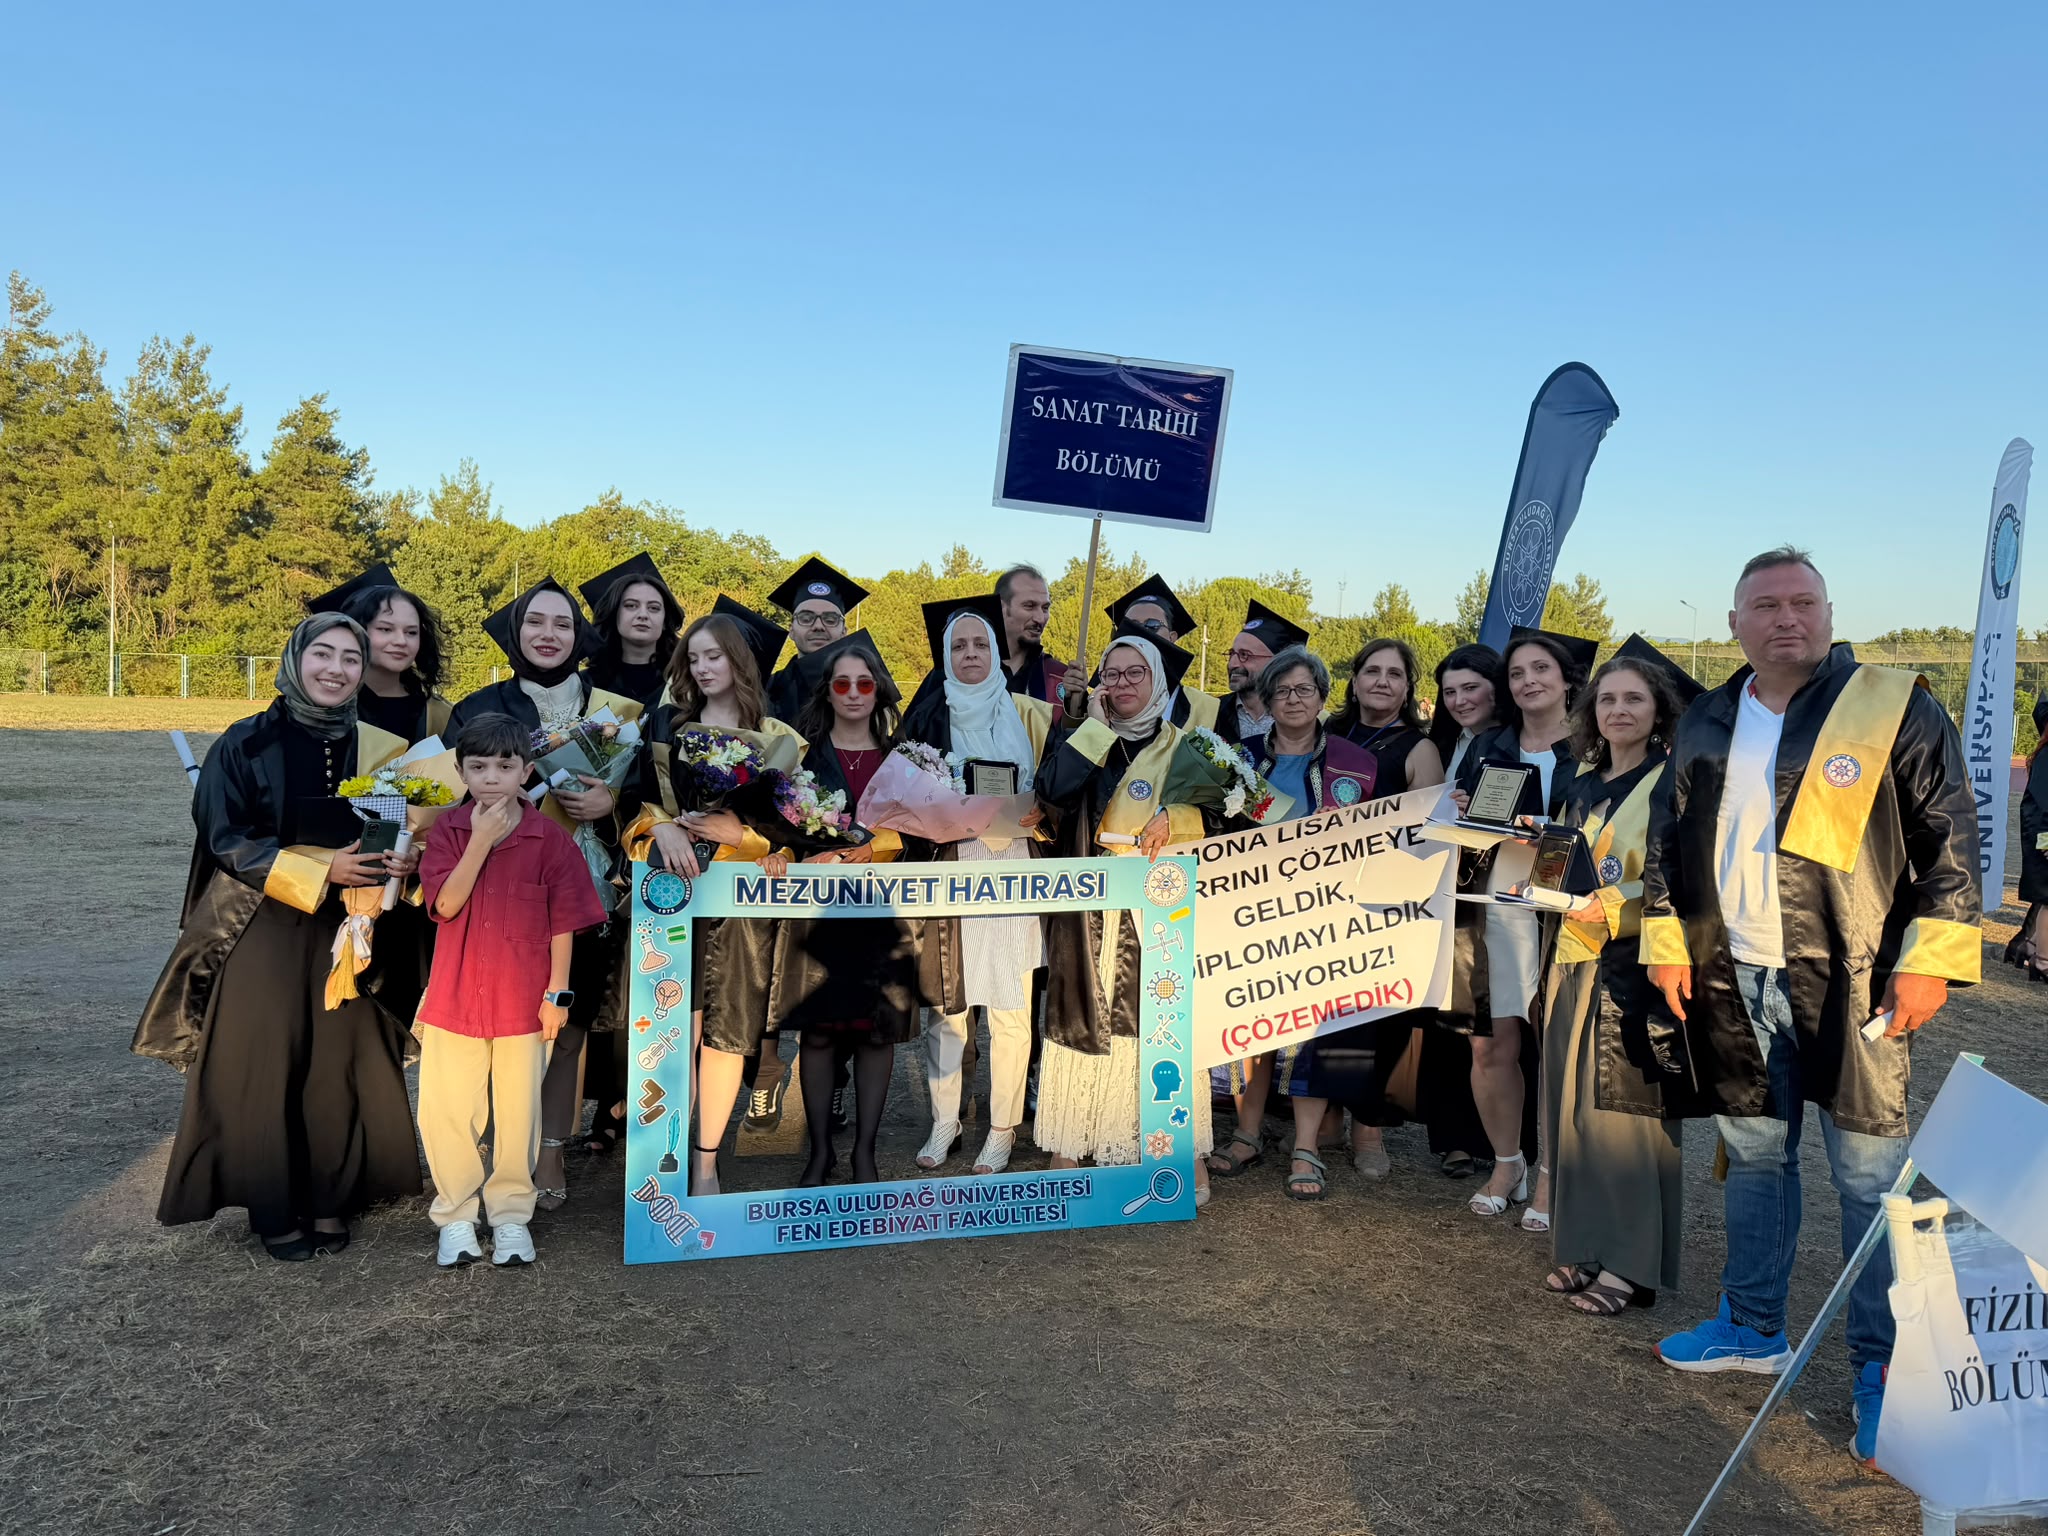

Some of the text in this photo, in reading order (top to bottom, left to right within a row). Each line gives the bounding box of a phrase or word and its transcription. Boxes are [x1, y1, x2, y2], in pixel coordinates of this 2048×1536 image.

[1031, 395, 1199, 437] SANAT TARİHİ
[1055, 449, 1161, 481] BÖLÜMÜ
[1195, 864, 1269, 898] RRINI
[1278, 823, 1427, 882] ÇÖZMEYE
[735, 869, 940, 906] MEZUNİYET
[948, 871, 1107, 902] HATIRASI
[1233, 881, 1355, 928] GELDİK,
[1193, 897, 1435, 980] İPLOMAYI ALDIK
[1224, 945, 1395, 1009] GİDİYORUZ!
[1221, 977, 1414, 1056] (ÇÖZEMEDİK)
[747, 1174, 1092, 1222] BURSA ULUDAĞ ÜNİVERSİTESİ
[777, 1200, 1068, 1244] FEN EDEBİYAT FAKÜLTESİ
